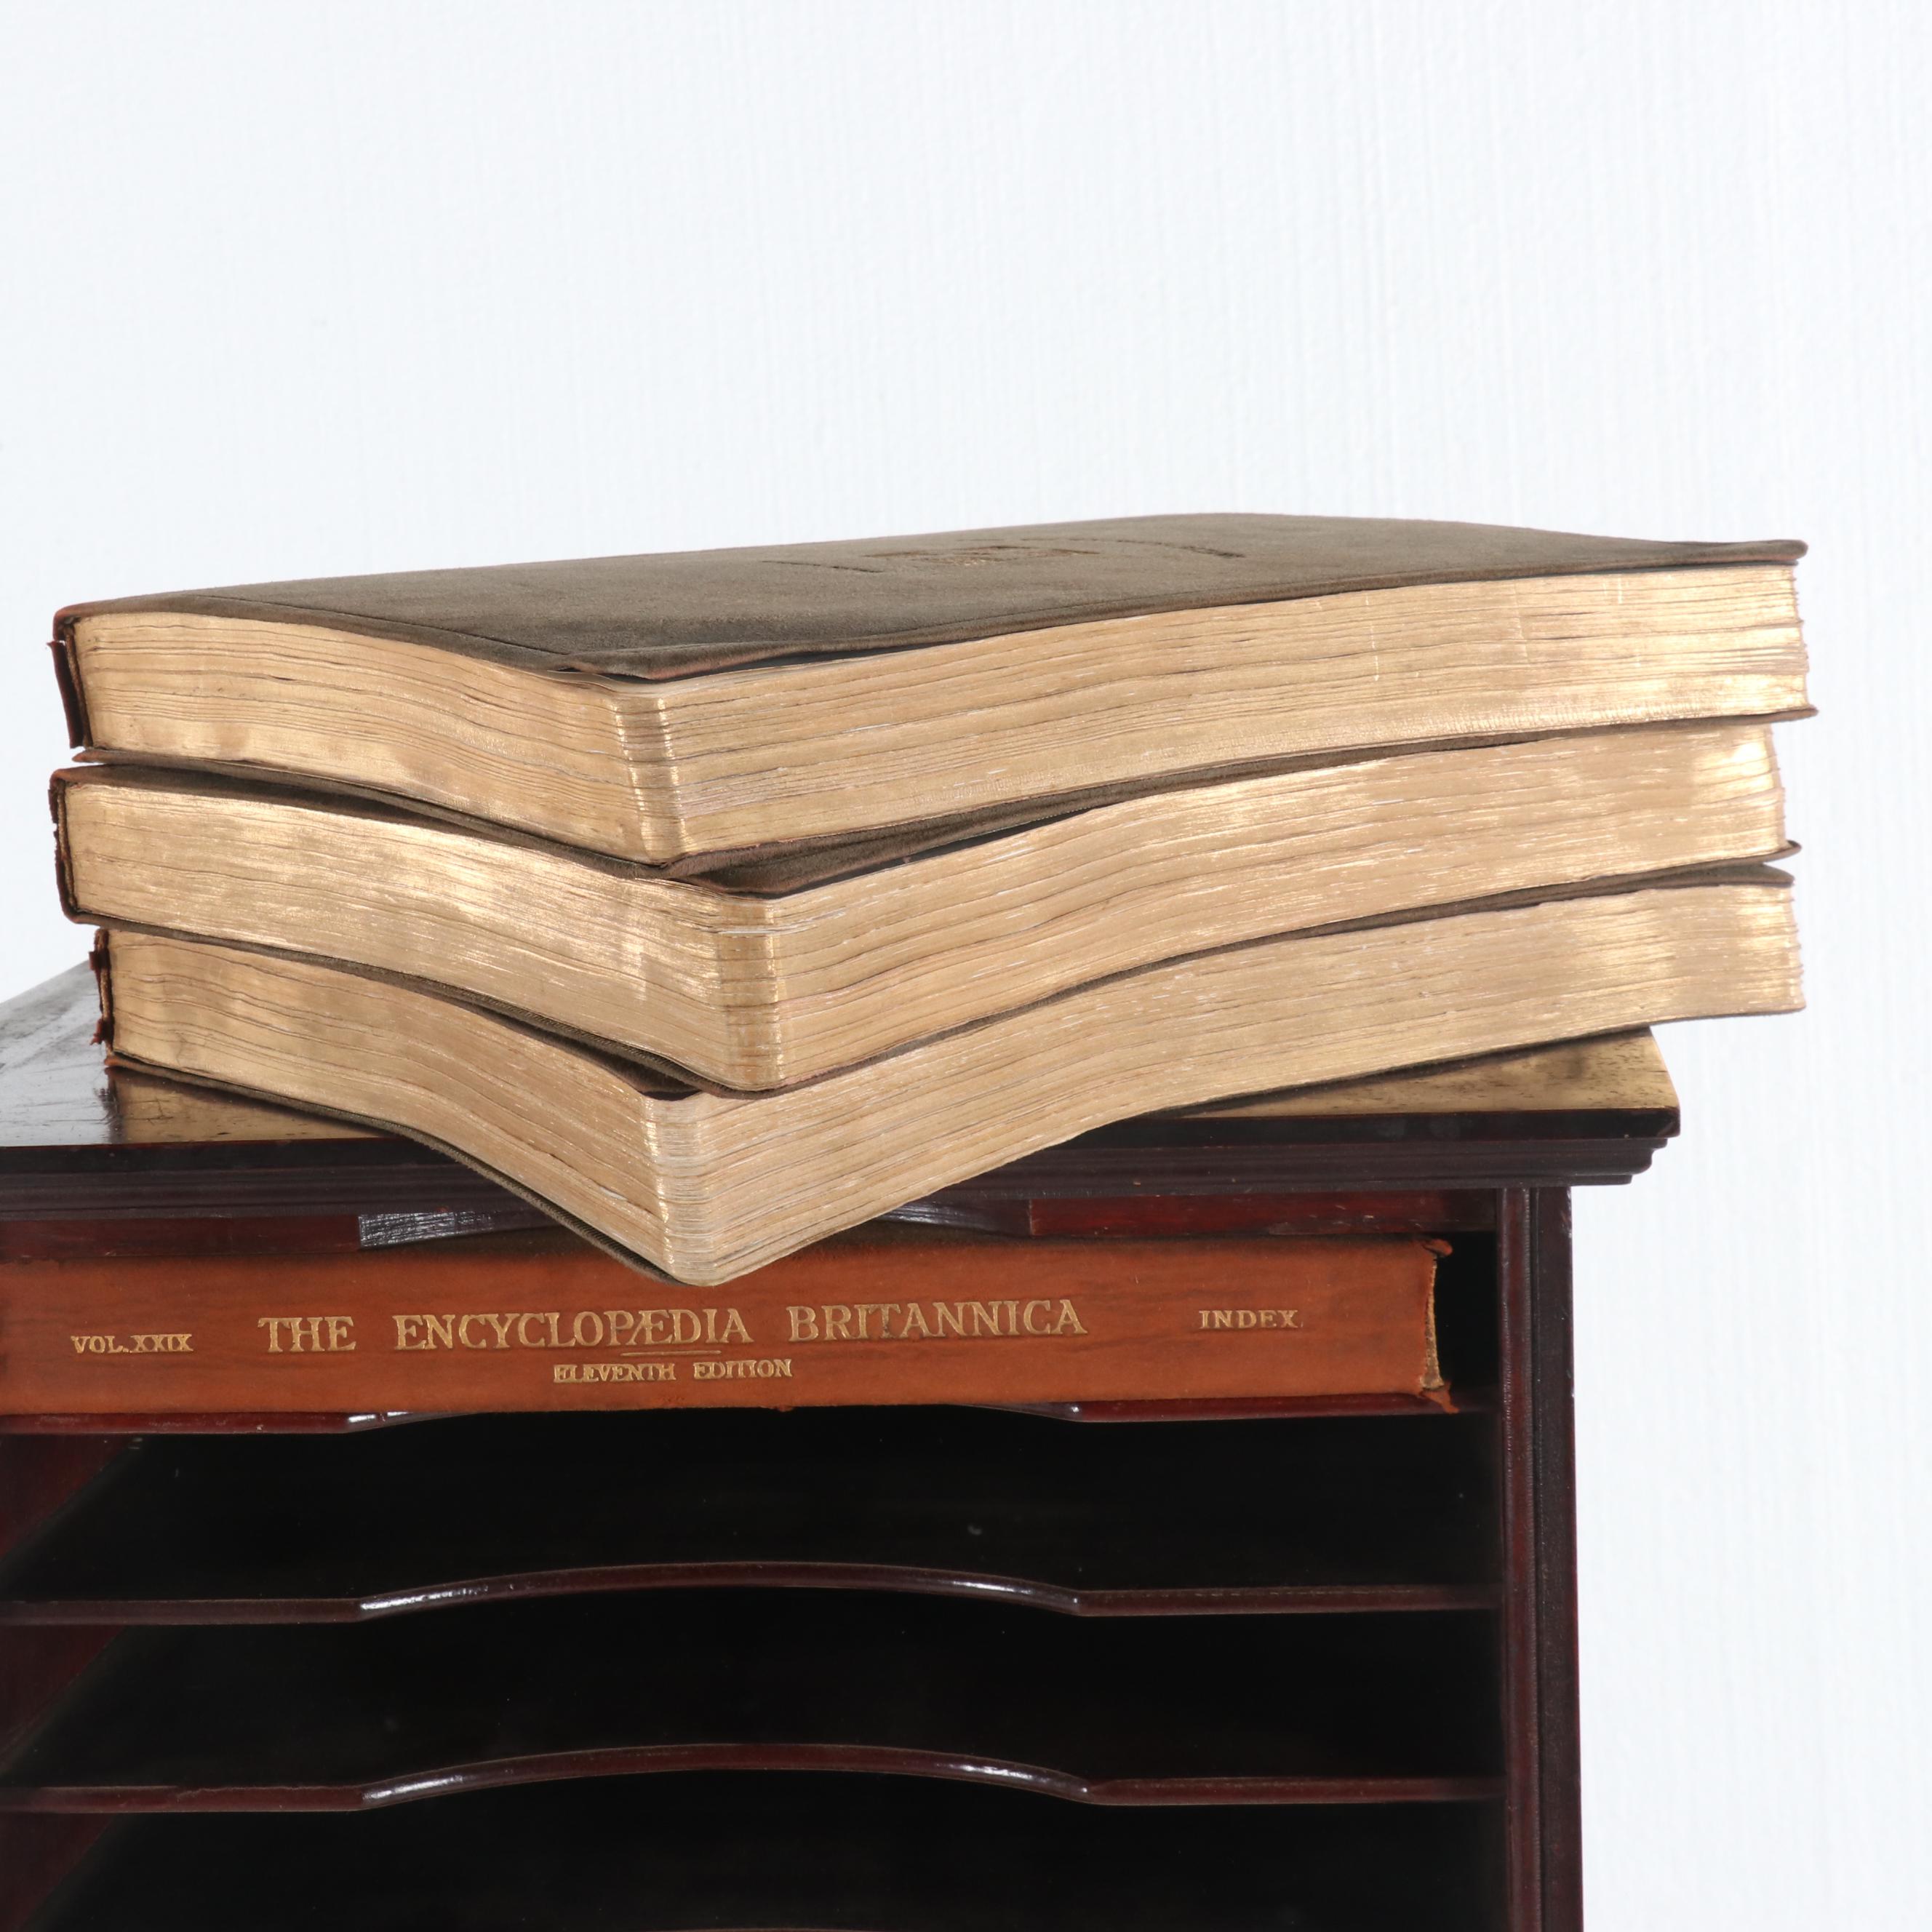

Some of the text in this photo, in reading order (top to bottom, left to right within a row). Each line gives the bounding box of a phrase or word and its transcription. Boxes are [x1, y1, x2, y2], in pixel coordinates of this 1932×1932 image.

[258, 1299, 1087, 1352] THE ENCYCLOPÆDIA BRITANNICA
[1199, 1310, 1298, 1329] INDEX
[554, 1359, 793, 1384] ELEVENTH EDITION
